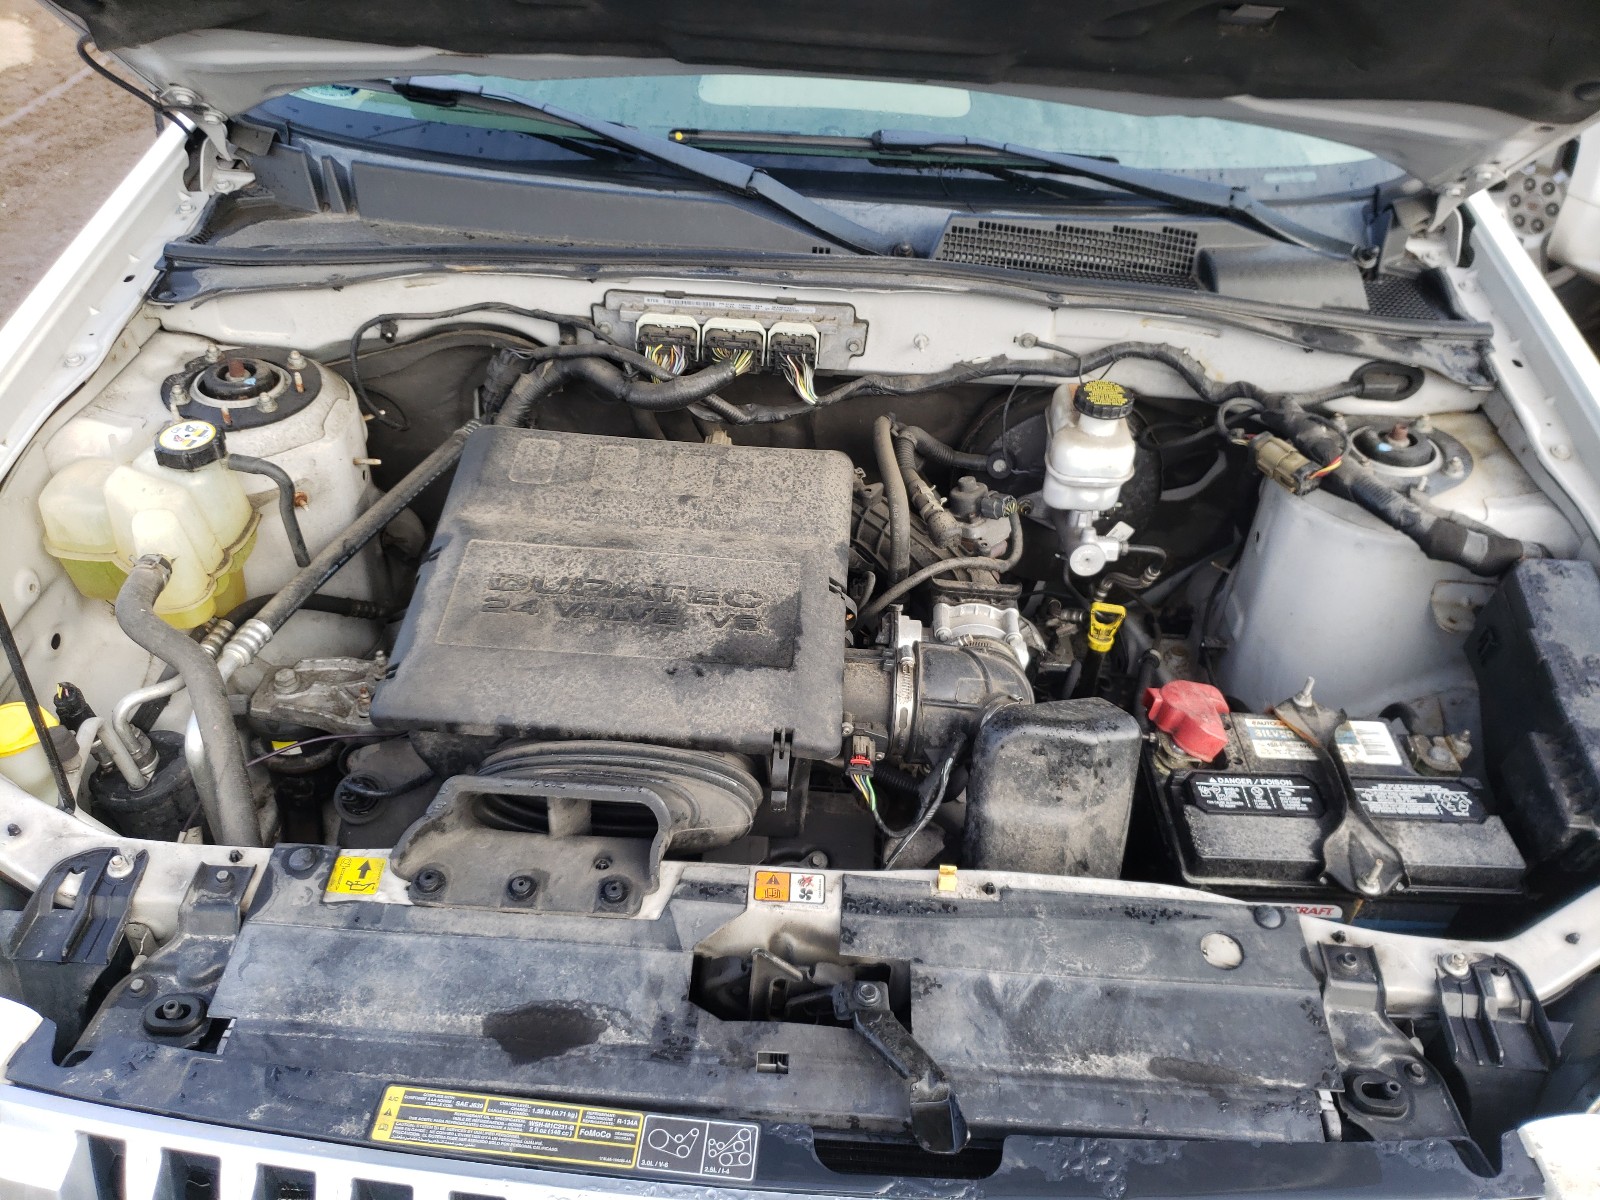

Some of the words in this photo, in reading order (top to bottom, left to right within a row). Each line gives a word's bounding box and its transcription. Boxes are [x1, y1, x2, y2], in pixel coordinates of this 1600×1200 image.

[482, 595, 541, 616] 24
[553, 598, 679, 626] VALVE
[1218, 777, 1252, 785] DANGER
[579, 1128, 611, 1138] FoMoCo
